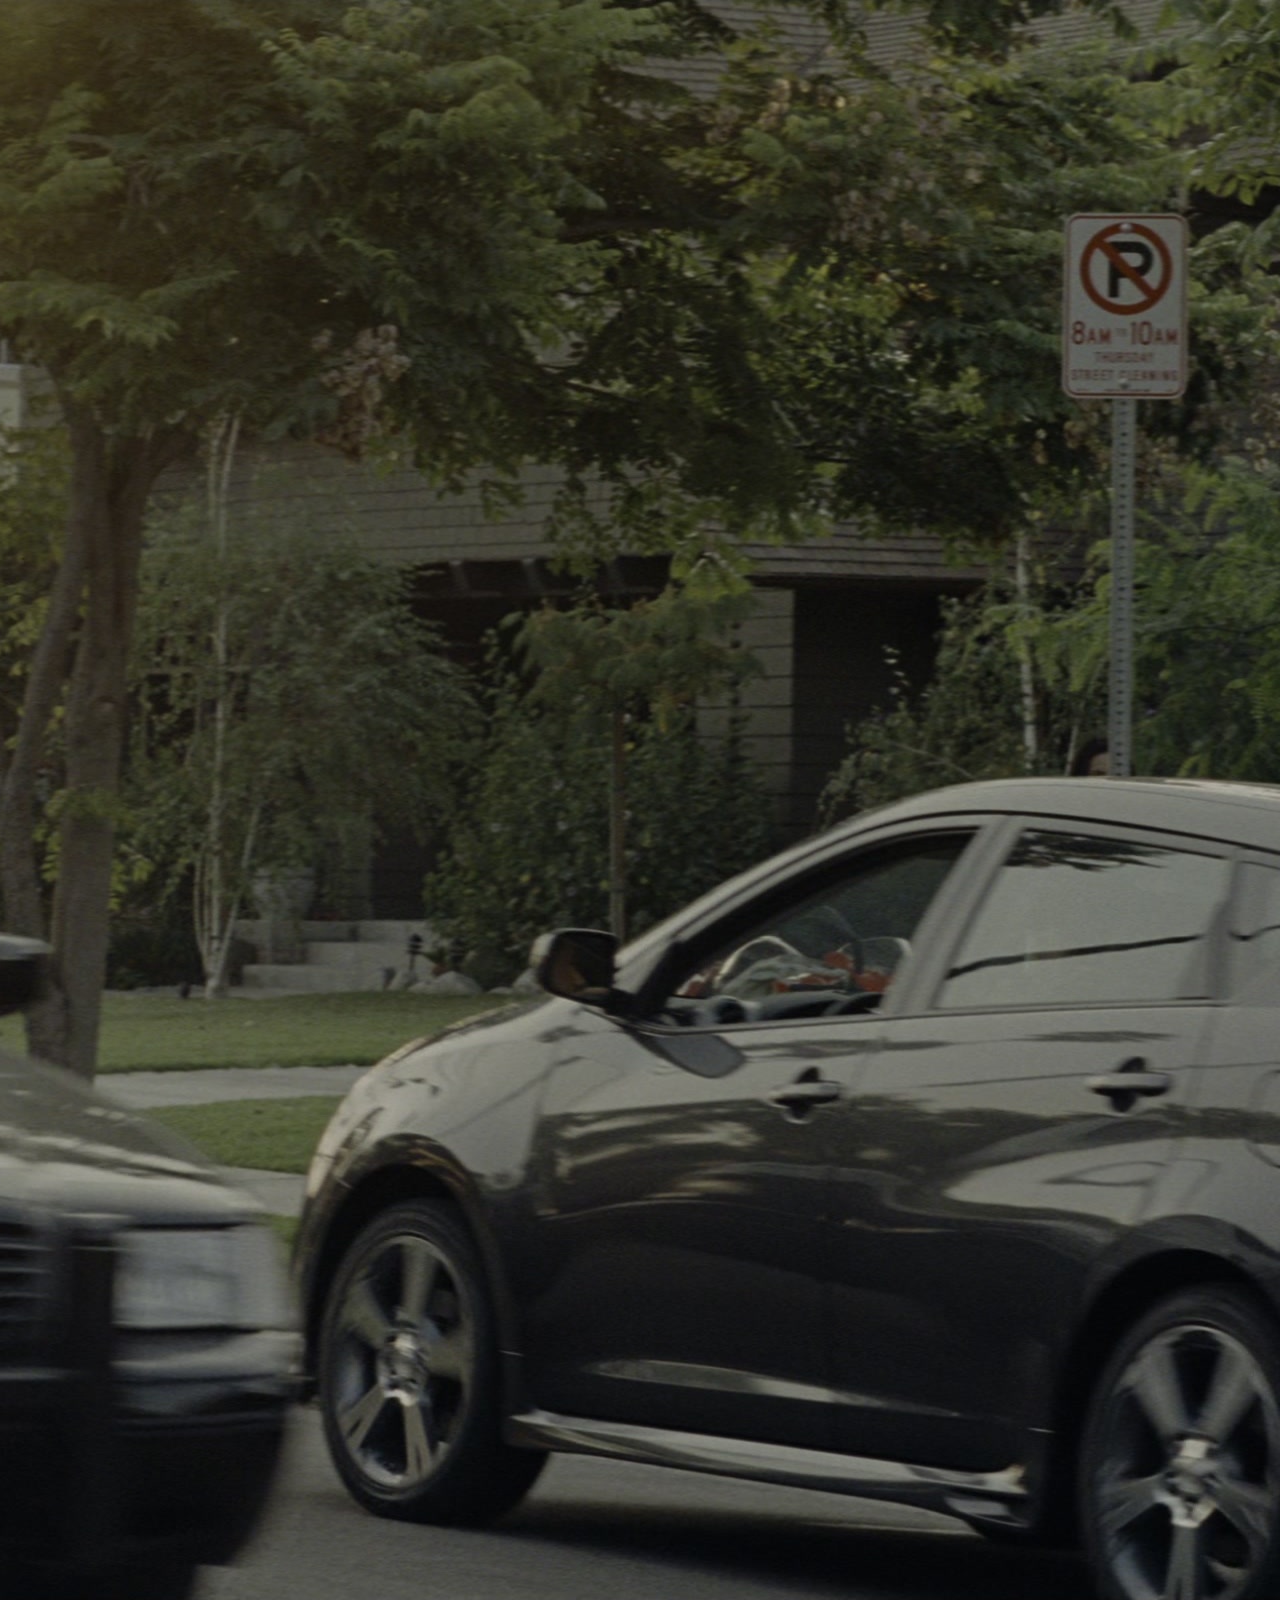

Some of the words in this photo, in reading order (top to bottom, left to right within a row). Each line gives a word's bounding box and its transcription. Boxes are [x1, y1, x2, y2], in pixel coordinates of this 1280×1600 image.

[1072, 320, 1112, 345] 8AM
[1130, 320, 1178, 345] 10AM
[1071, 369, 1114, 381] STREET
